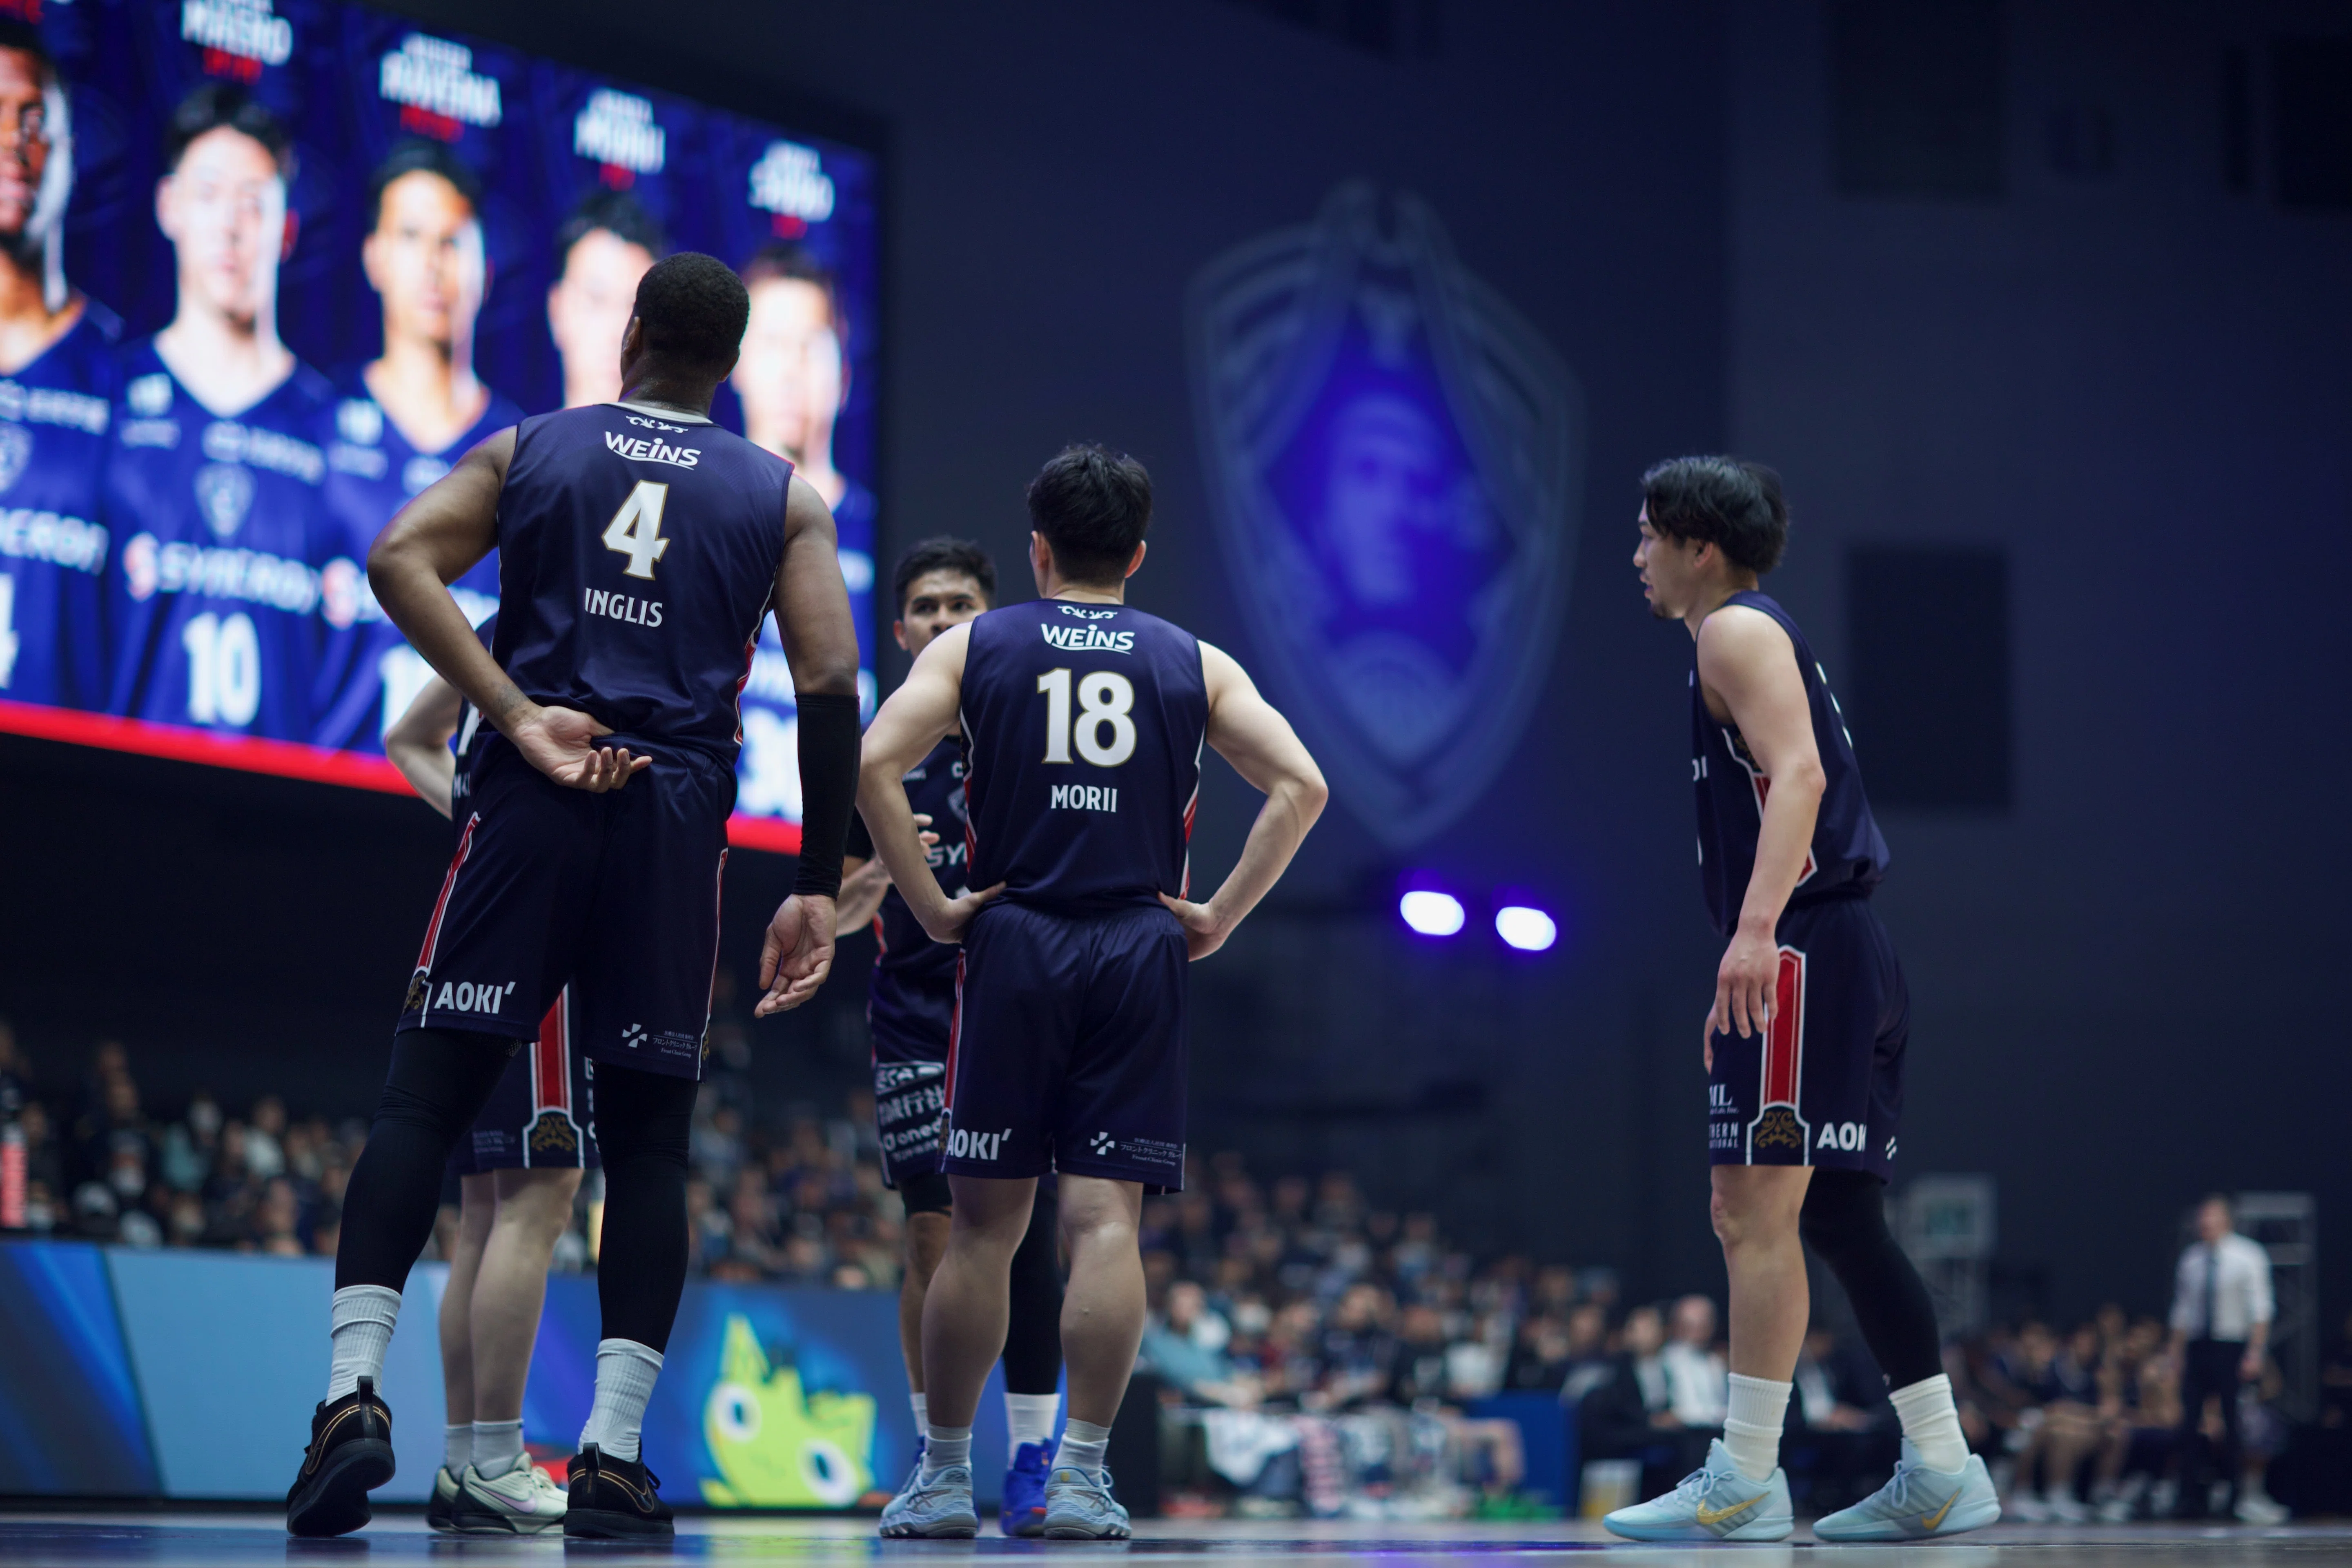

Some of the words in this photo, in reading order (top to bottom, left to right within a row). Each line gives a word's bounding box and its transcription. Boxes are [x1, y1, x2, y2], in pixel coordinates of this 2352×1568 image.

[601, 479, 670, 580] 4
[585, 587, 662, 628] INGLIS
[184, 611, 261, 726] 10
[1037, 667, 1137, 768] 18
[1051, 785, 1118, 813] MORII
